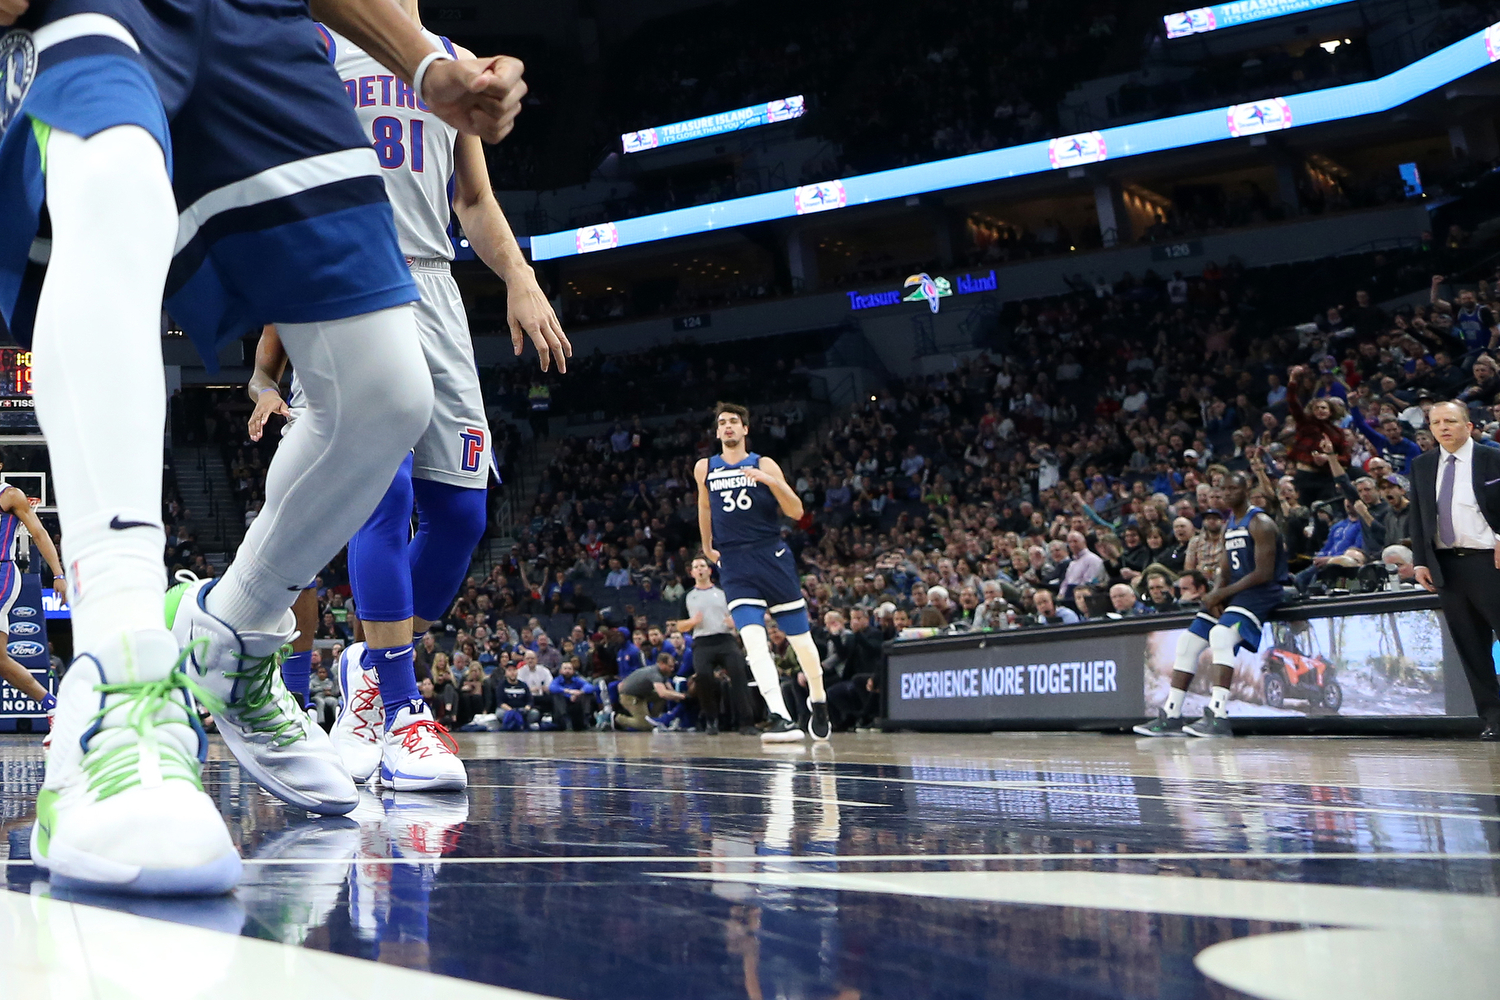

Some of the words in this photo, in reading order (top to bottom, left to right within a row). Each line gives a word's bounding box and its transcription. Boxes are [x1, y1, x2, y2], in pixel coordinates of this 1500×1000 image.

[1281, 1, 1312, 14] THAN
[343, 75, 432, 113] DETR
[662, 118, 713, 137] TREASURE
[701, 125, 723, 136] THAN
[372, 116, 424, 173] 81
[846, 290, 901, 310] Treasure
[956, 270, 998, 295] Island
[682, 316, 702, 328] 124
[720, 489, 752, 512] 36
[1231, 550, 1240, 570] 5
[901, 668, 979, 700] EXPERIENCE
[981, 665, 1025, 696] MORE
[1027, 660, 1117, 694] TOGETHER
[2, 700, 46, 711] NORT
